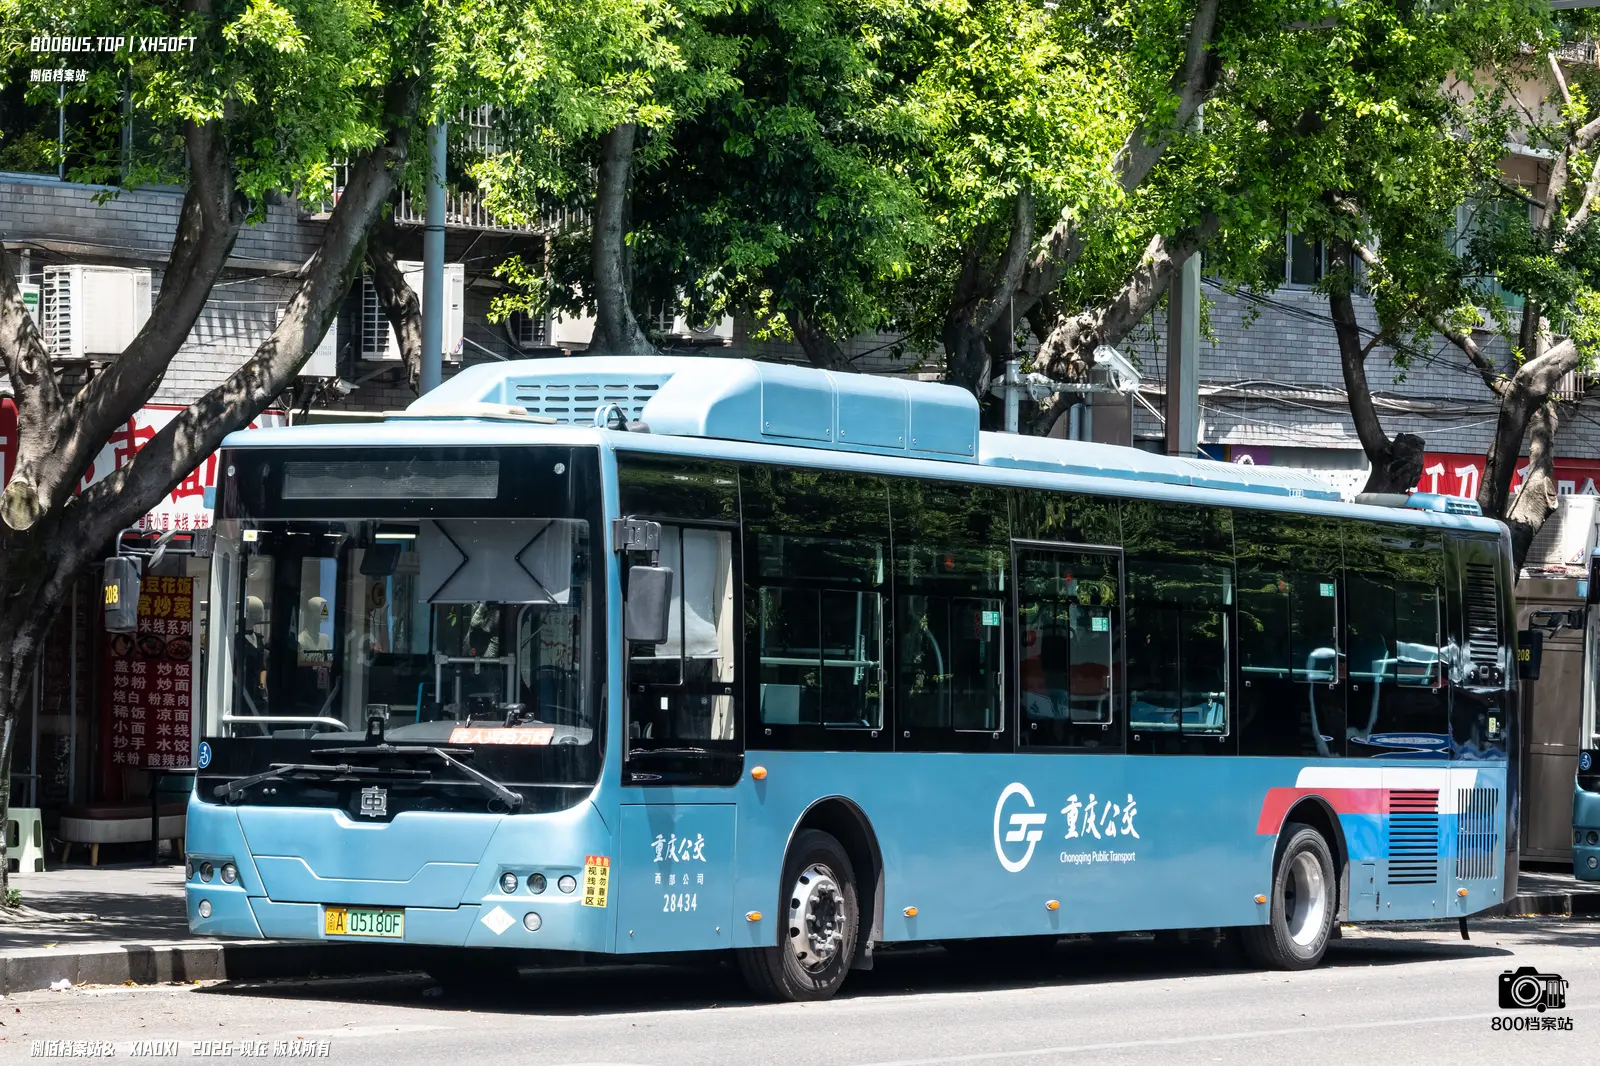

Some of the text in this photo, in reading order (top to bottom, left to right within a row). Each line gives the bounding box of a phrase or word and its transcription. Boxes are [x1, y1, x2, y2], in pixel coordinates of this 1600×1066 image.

[139, 512, 209, 531] 重庆小面 米线 米粉
[105, 584, 118, 604] 208
[140, 576, 192, 595] 豆花饭
[140, 618, 192, 636] 米线系列
[113, 660, 190, 677] 盖饭 炒饭
[113, 674, 189, 692] 炒粉 炒面
[113, 690, 190, 707] 烧白 粉蒸肉
[113, 705, 146, 720] 稀饭
[113, 721, 190, 738] 小面 米线
[113, 736, 190, 753] 抄手 水饺
[112, 751, 190, 768] 米粉 酸辣粉
[1060, 793, 1140, 840] 重庆公交
[651, 833, 707, 863] 重庆公交
[1060, 850, 1136, 865] Chongqing Public Transport
[585, 866, 597, 906] 视线盲区
[597, 867, 607, 907] 请勿靠近
[654, 872, 704, 886] 西部公司
[663, 893, 697, 913] 28434
